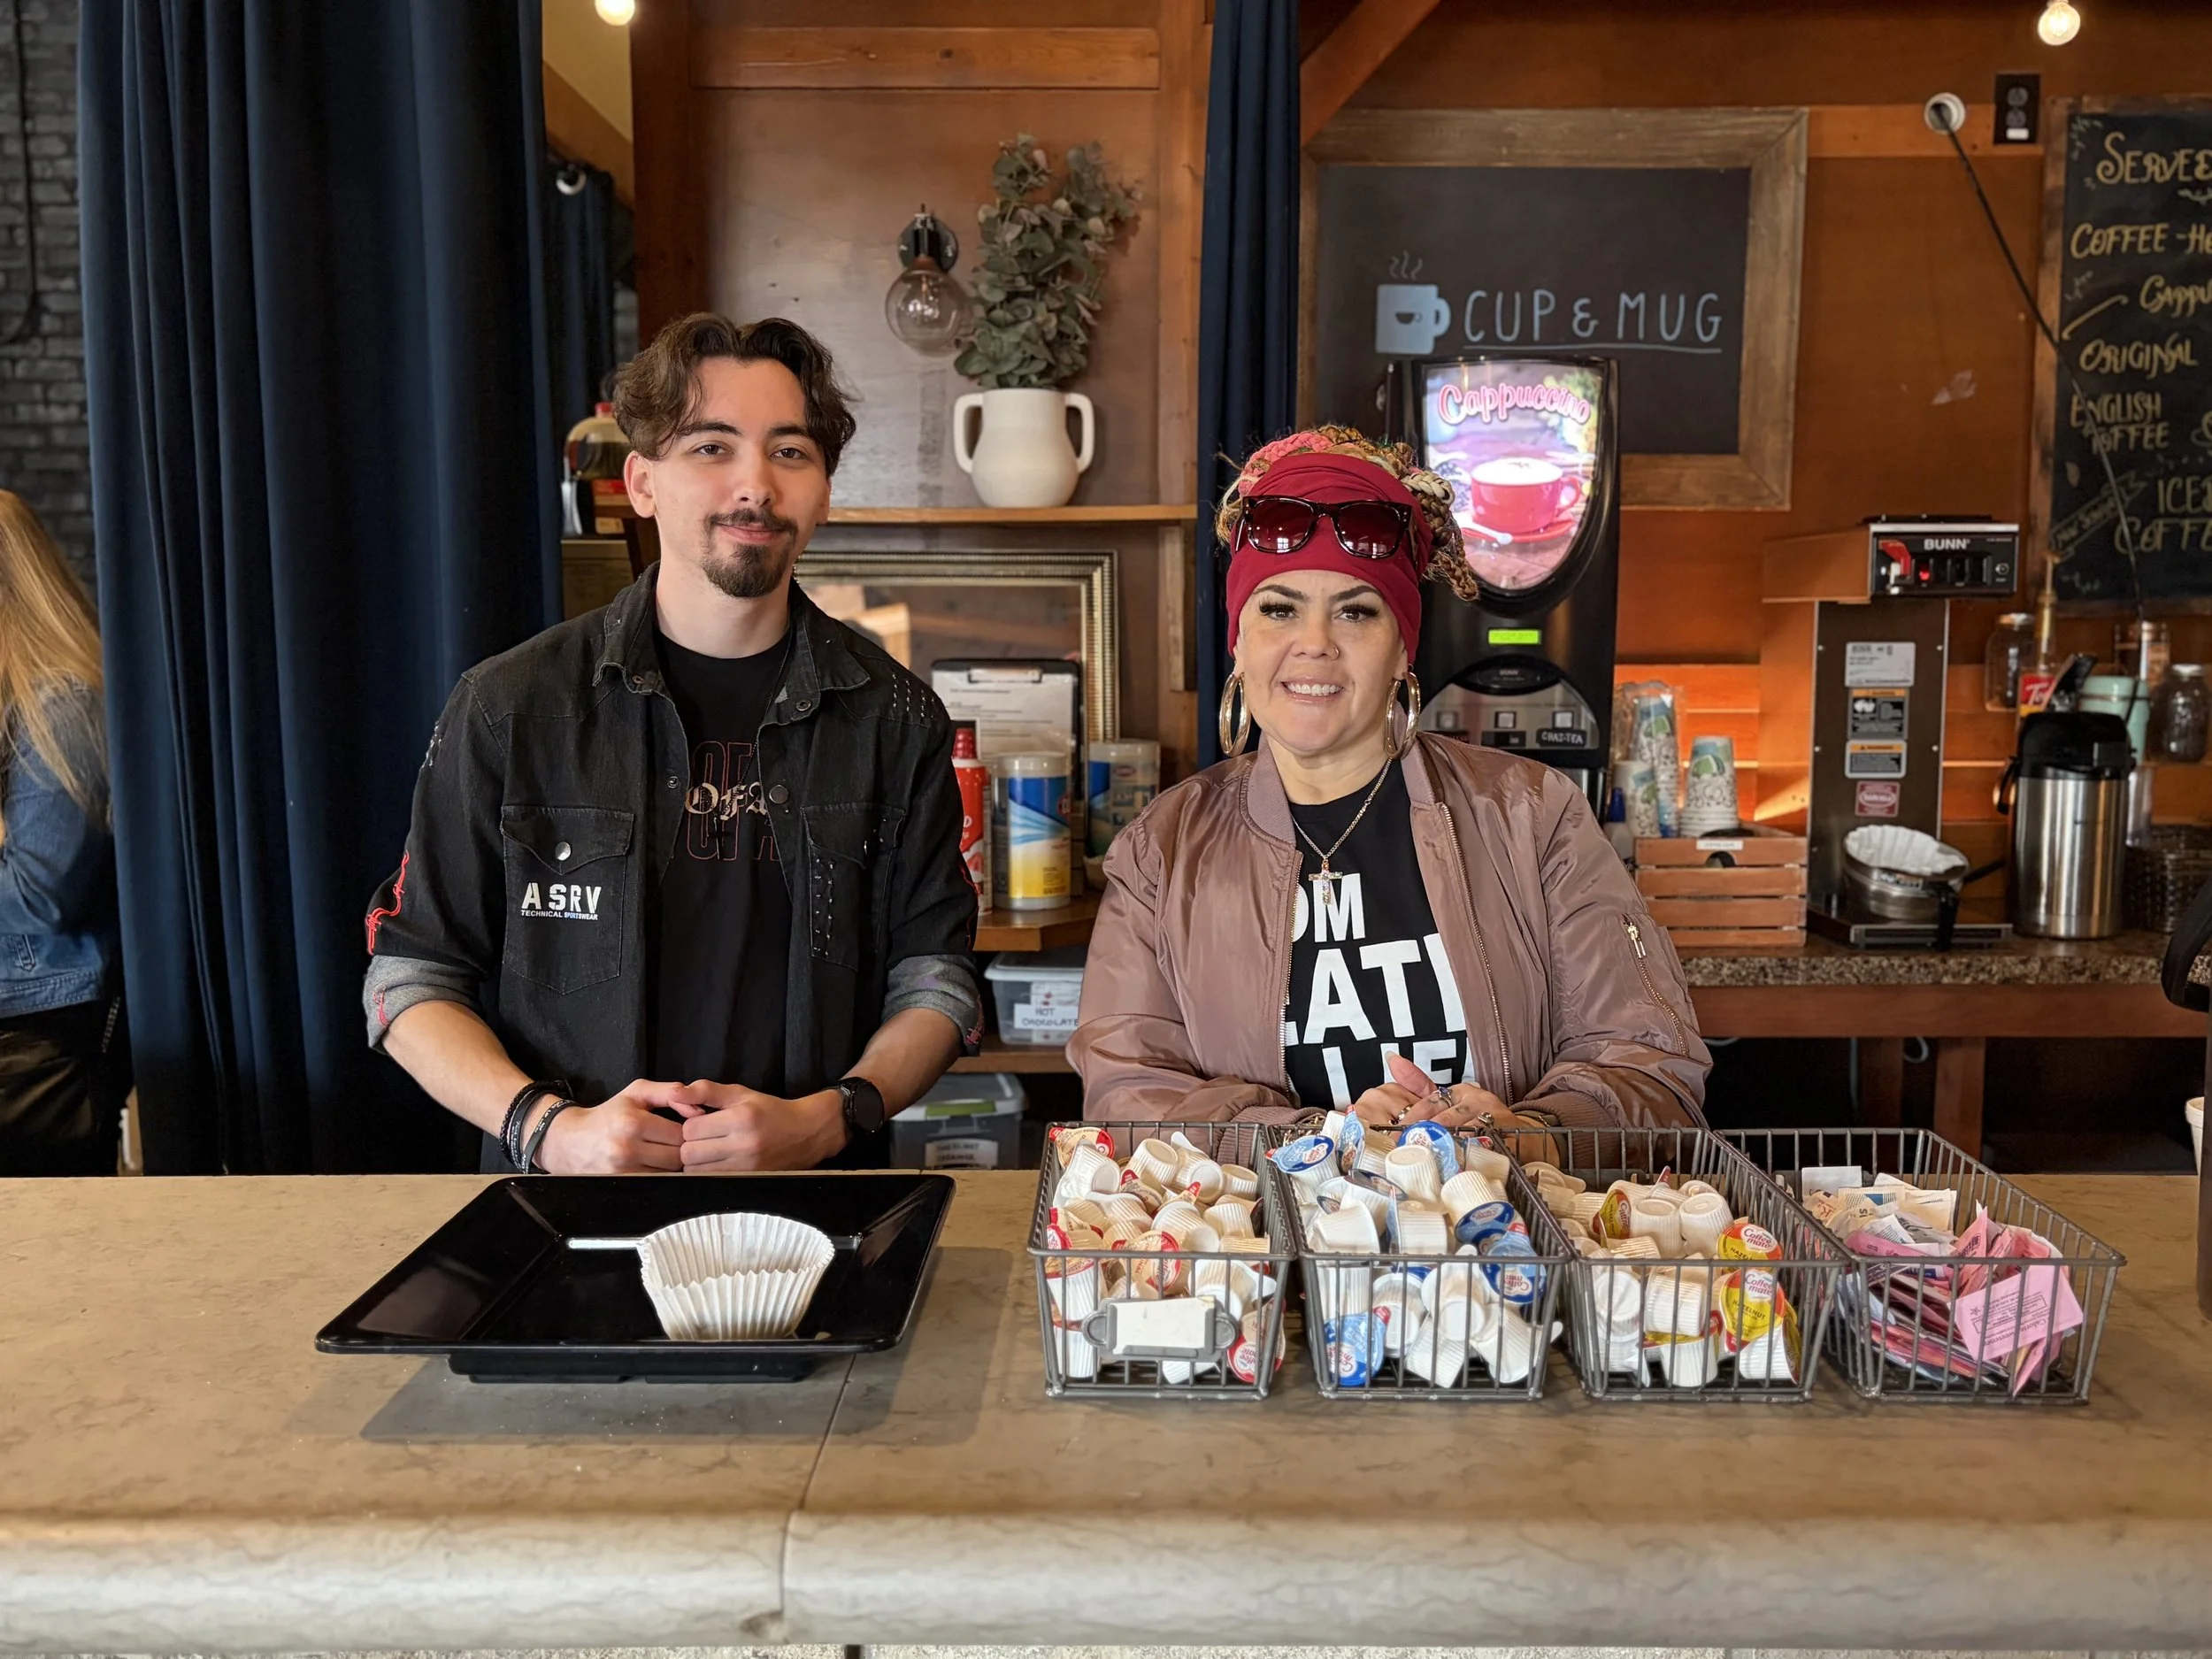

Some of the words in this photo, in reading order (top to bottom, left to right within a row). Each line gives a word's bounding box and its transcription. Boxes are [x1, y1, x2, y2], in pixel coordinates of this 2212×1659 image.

[2070, 223, 2170, 259] COFFEE
[1463, 289, 1556, 342] CUP
[1572, 297, 1599, 338] &
[1617, 292, 1723, 343] MUG
[2080, 333, 2200, 379] ORIGINAL
[1438, 382, 1592, 426] Cappuccino
[2070, 391, 2162, 428] ENGLISH
[1924, 538, 1968, 550] BUNN
[520, 910, 563, 918] TECHNICAL
[564, 911, 598, 920] SPORTSWEAR
[1035, 1008, 1056, 1017] HOT
[1744, 1228, 1772, 1245] Coffee
[1747, 1238, 1771, 1248] mate
[1133, 1242, 1149, 1274] ORINAL
[1731, 1248, 1753, 1261] HAZEL
[1503, 1279, 1528, 1291] Coffe
[1748, 1285, 1774, 1296] mate
[1981, 1330, 2016, 1347] weetene
